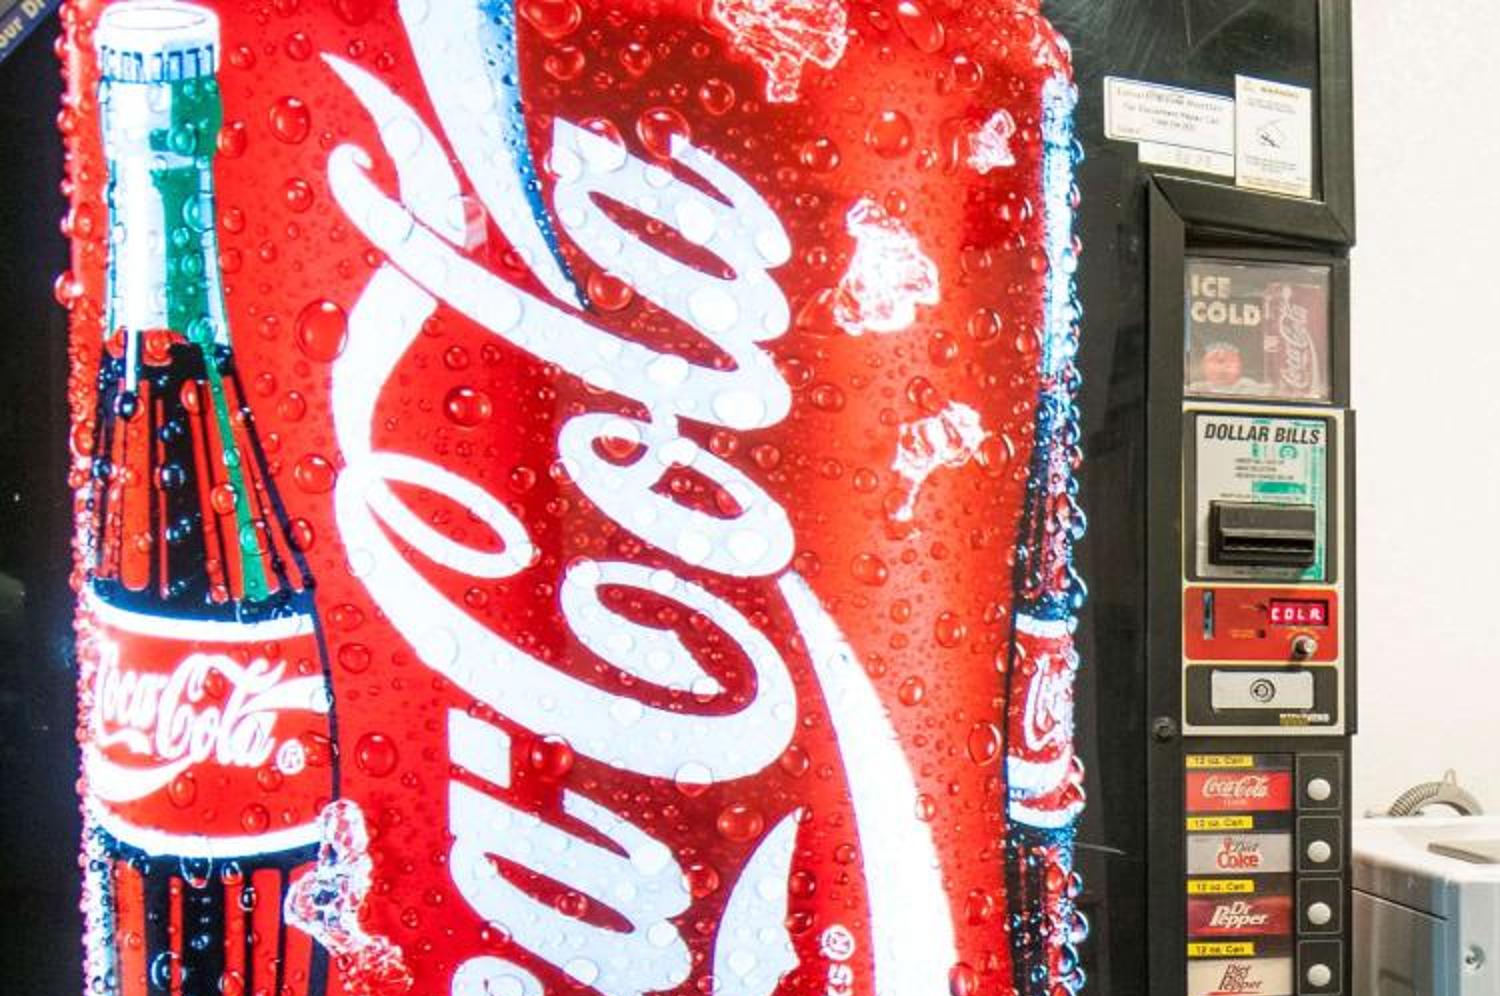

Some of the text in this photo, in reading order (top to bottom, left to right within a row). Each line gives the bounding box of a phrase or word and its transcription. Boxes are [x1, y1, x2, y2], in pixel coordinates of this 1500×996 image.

[1191, 273, 1231, 299] ICE
[1191, 300, 1261, 326] COLD
[1203, 423, 1321, 445] DOLLAR BILLS
[1202, 775, 1269, 798] Coca-Cola
[1217, 851, 1260, 868] Coke
[1209, 905, 1269, 928] Pepper
[1231, 901, 1251, 914] Dr
